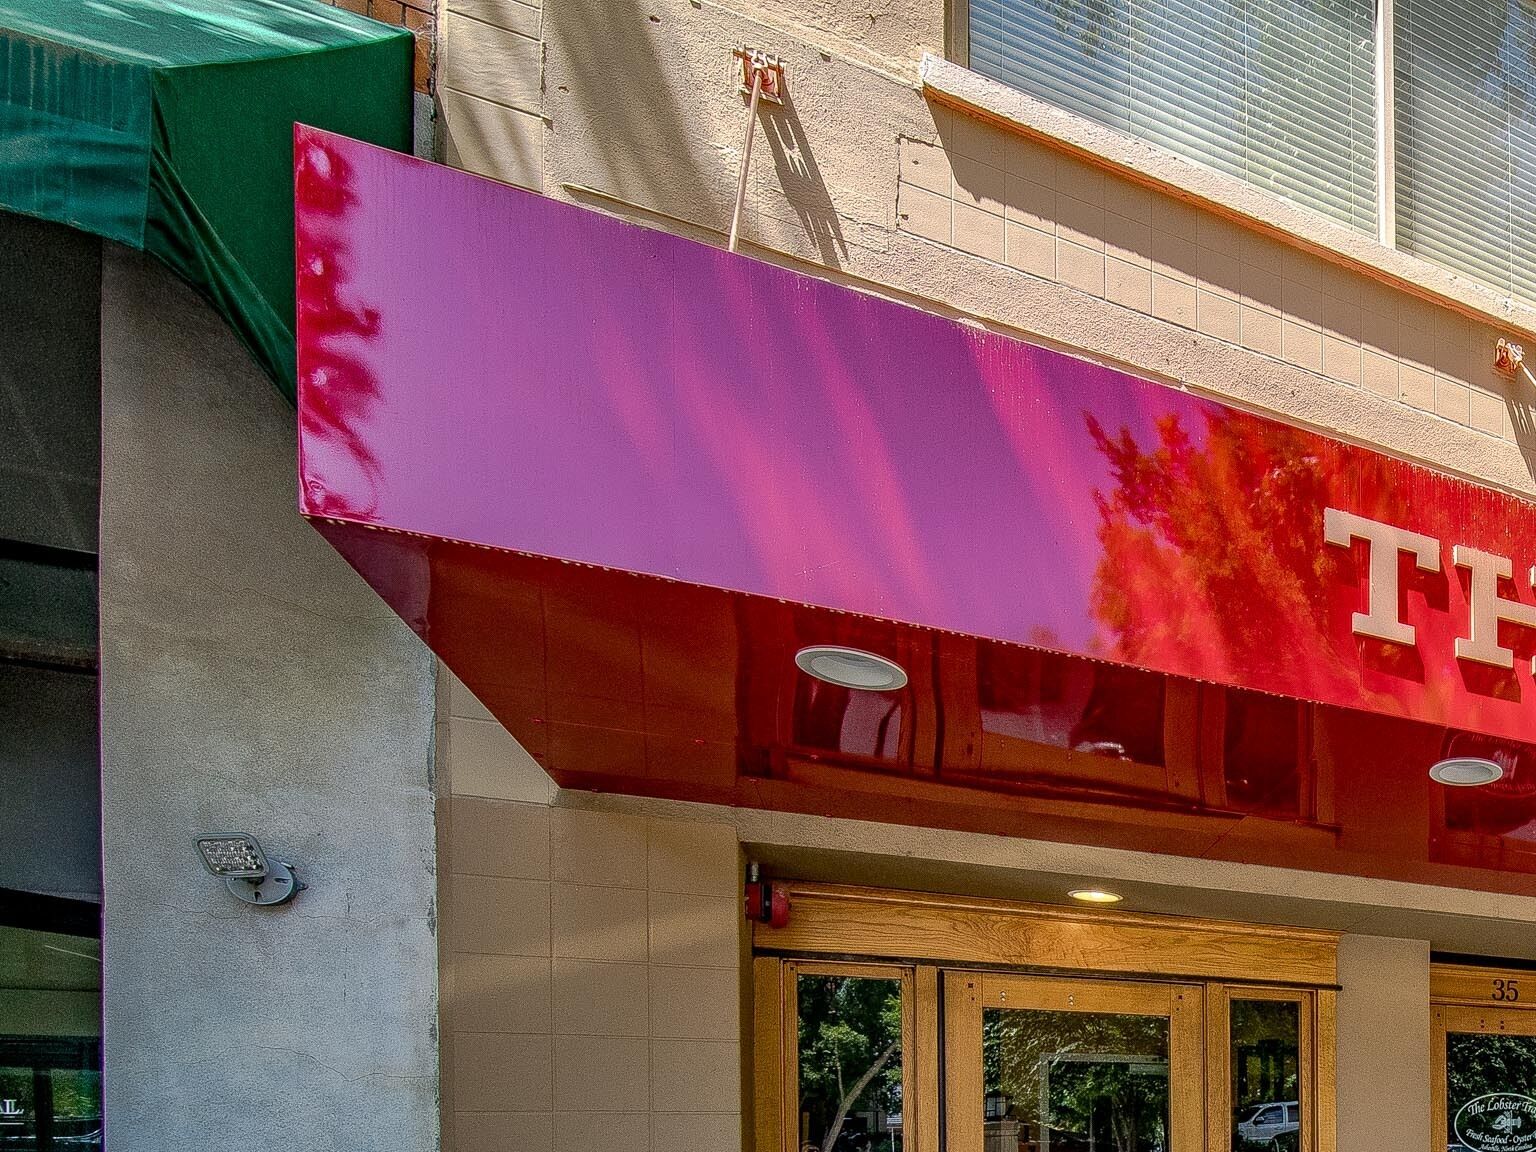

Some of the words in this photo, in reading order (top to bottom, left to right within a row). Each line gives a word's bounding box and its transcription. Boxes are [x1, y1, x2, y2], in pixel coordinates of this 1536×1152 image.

[1491, 978, 1520, 1002] 35
[1467, 1101, 1485, 1116] The
[1486, 1097, 1521, 1112] Lobster
[1465, 1128, 1483, 1142] Fresh
[1482, 1134, 1508, 1146] Seafood
[1512, 1135, 1532, 1146] Oyster
